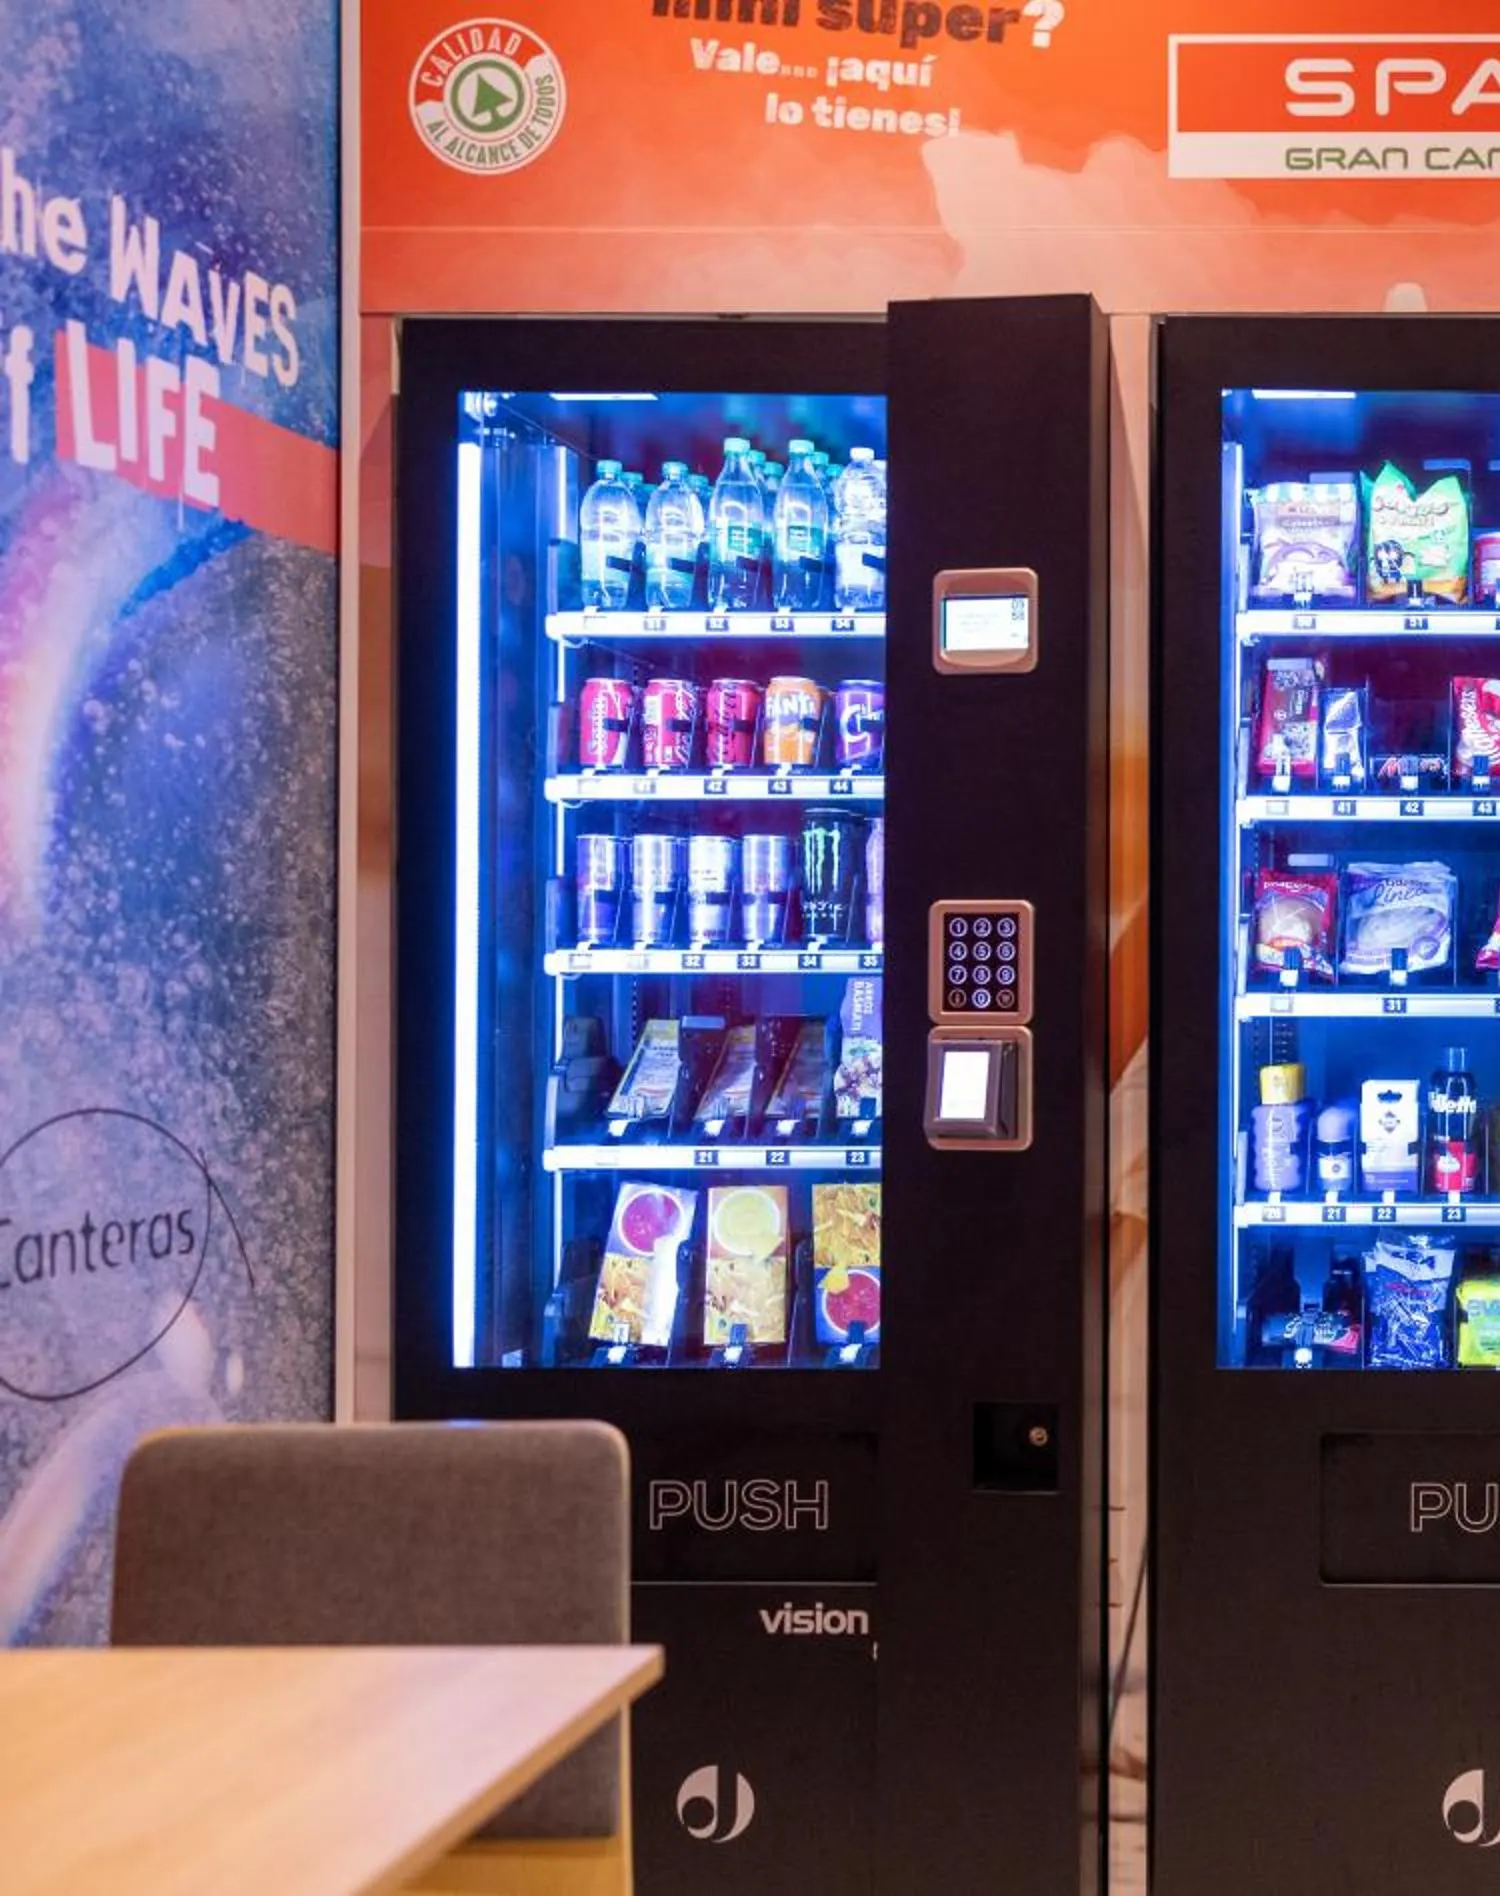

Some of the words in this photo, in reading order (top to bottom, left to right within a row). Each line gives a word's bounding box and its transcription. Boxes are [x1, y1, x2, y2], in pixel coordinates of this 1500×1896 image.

[420, 27, 522, 88] CALIDAD
[427, 119, 450, 142] AL
[443, 136, 521, 165] ALCANCE
[518, 126, 542, 149] DE
[533, 74, 556, 127] TODOS
[765, 92, 804, 126] lo
[811, 94, 962, 138] tienes!
[1285, 147, 1408, 170] GRAN
[111, 194, 299, 387] WAVES
[66, 319, 220, 508] LIFE
[0, 1209, 196, 1290] anteras
[649, 1479, 829, 1531] PUSH
[760, 1602, 869, 1635] vision
